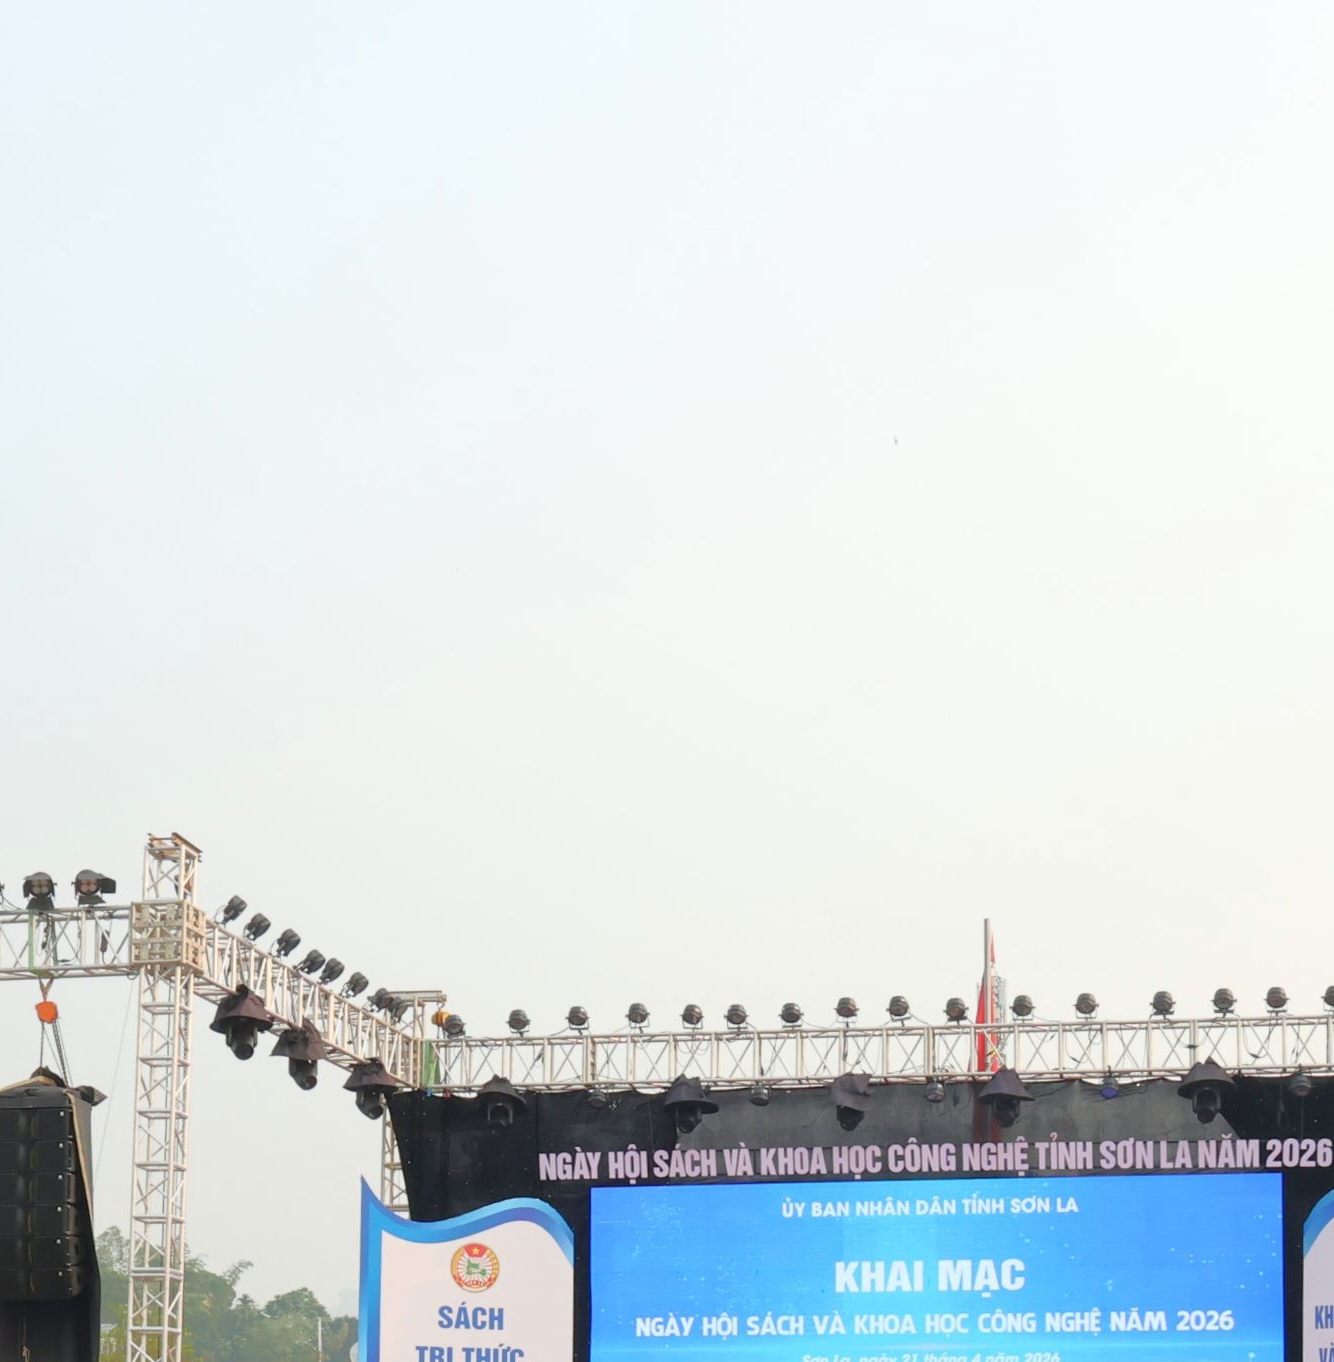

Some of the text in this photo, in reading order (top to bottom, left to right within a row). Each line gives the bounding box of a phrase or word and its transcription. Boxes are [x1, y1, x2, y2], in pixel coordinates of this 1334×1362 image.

[539, 1132, 1333, 1184] NGÀY HỘI SÁCH VÀ KHOA HỌC CÔNG NGHỆ TỈNH SƠN LA NĂM 2026
[782, 1196, 805, 1218] ỦY
[811, 1201, 850, 1217] BAN
[856, 1196, 909, 1216] NHÂN
[916, 1195, 956, 1215] DÂN
[1010, 1195, 1050, 1214] SƠN
[1056, 1197, 1079, 1213] LA
[835, 1258, 1025, 1298] KHAI MẠC
[438, 1301, 504, 1330] SÁCH
[636, 1307, 1234, 1340] NGÀY HỘI SÁCH VÀ KHOA HỌC CÔNG NGHỆ NĂM 2026
